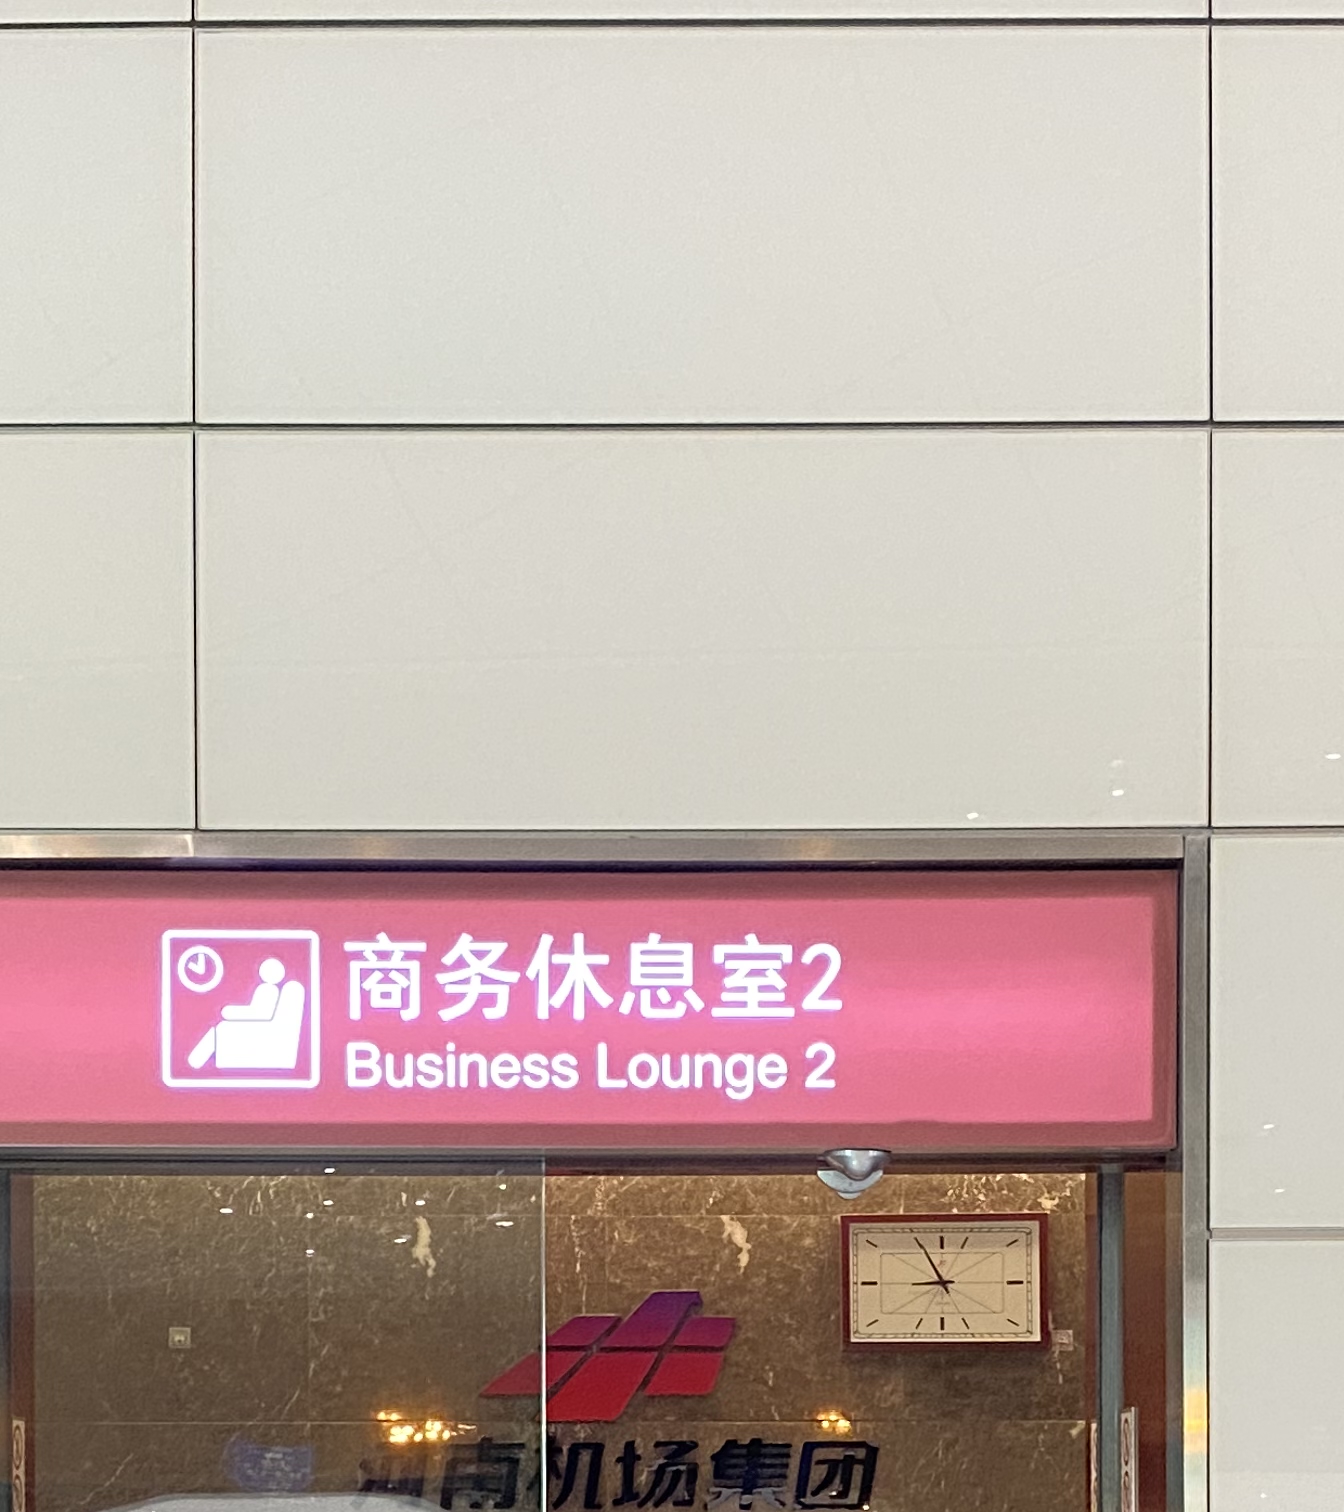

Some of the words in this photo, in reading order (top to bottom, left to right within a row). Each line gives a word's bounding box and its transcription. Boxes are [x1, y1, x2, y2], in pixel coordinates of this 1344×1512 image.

[343, 932, 843, 1021] 商务休息室2
[345, 1042, 579, 1089] Business
[597, 1042, 789, 1101] Lounge
[804, 1042, 836, 1088] 2
